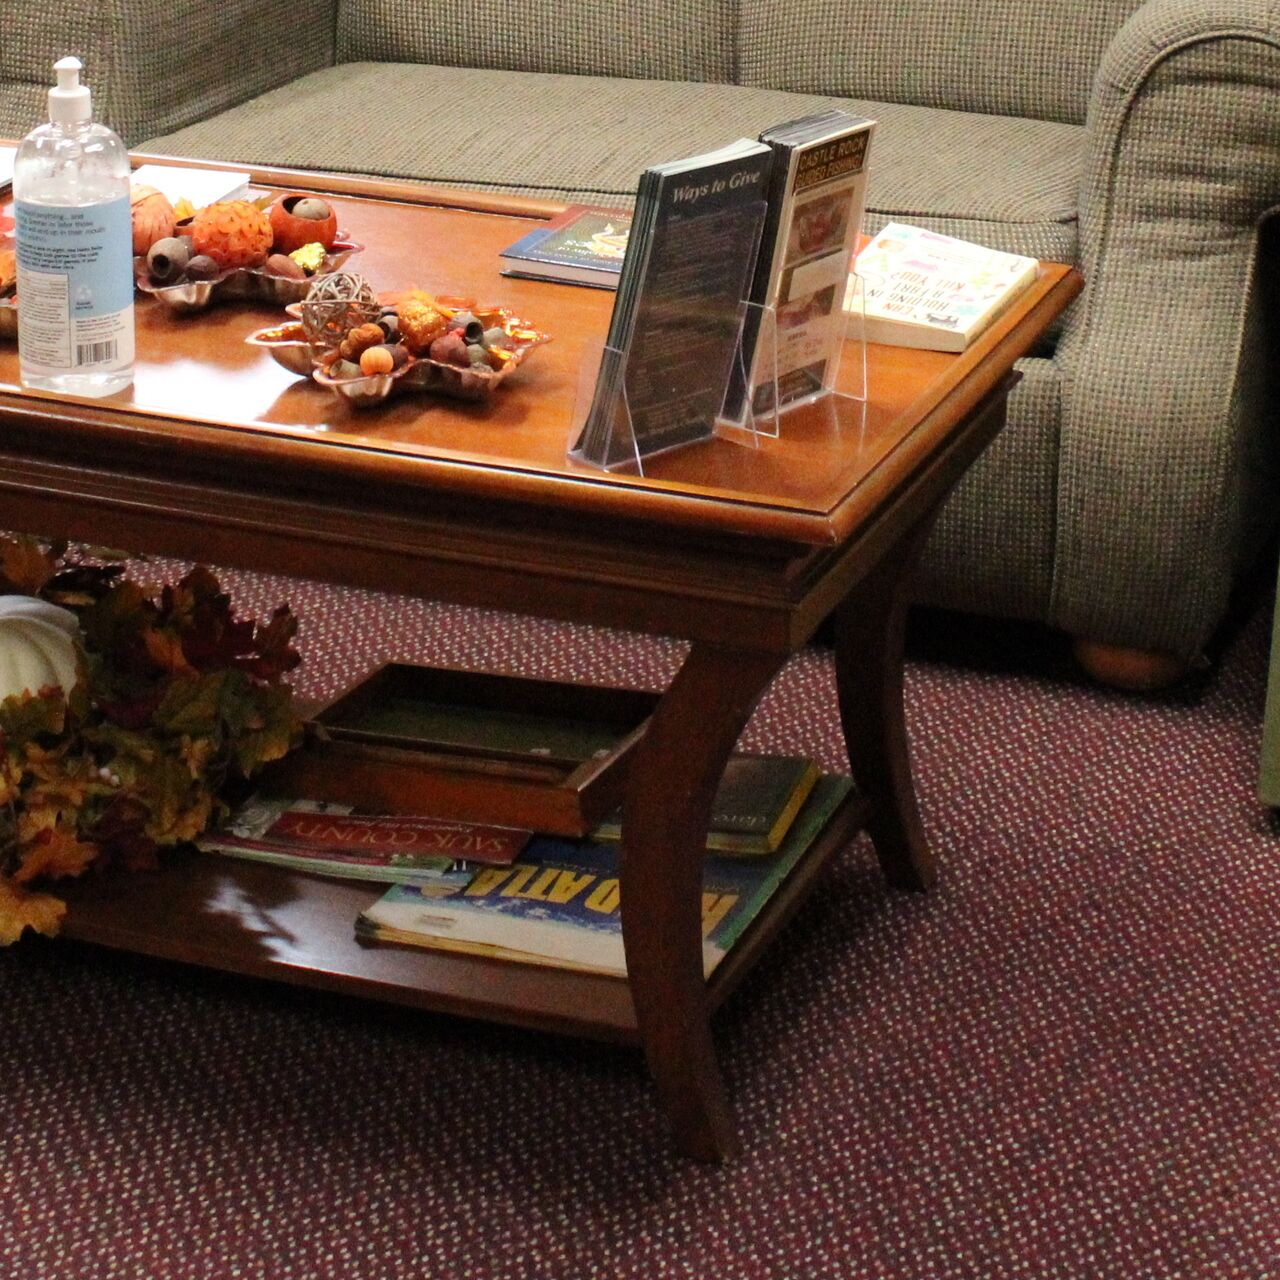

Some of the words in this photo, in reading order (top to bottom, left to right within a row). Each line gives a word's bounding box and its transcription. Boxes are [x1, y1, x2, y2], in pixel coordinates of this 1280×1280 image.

[800, 144, 837, 170] CASTLE
[839, 136, 865, 158] ROCK
[673, 183, 710, 204] Ways
[711, 179, 726, 194] to
[728, 170, 761, 190] Give
[796, 165, 827, 188] GUIDED
[868, 288, 883, 299] IN
[894, 282, 929, 297] FART
[936, 279, 966, 291] KILL
[889, 293, 950, 312] HOLDING
[284, 821, 418, 846] COUNTY
[434, 832, 509, 853] SAUK
[463, 864, 597, 905] ATLA
